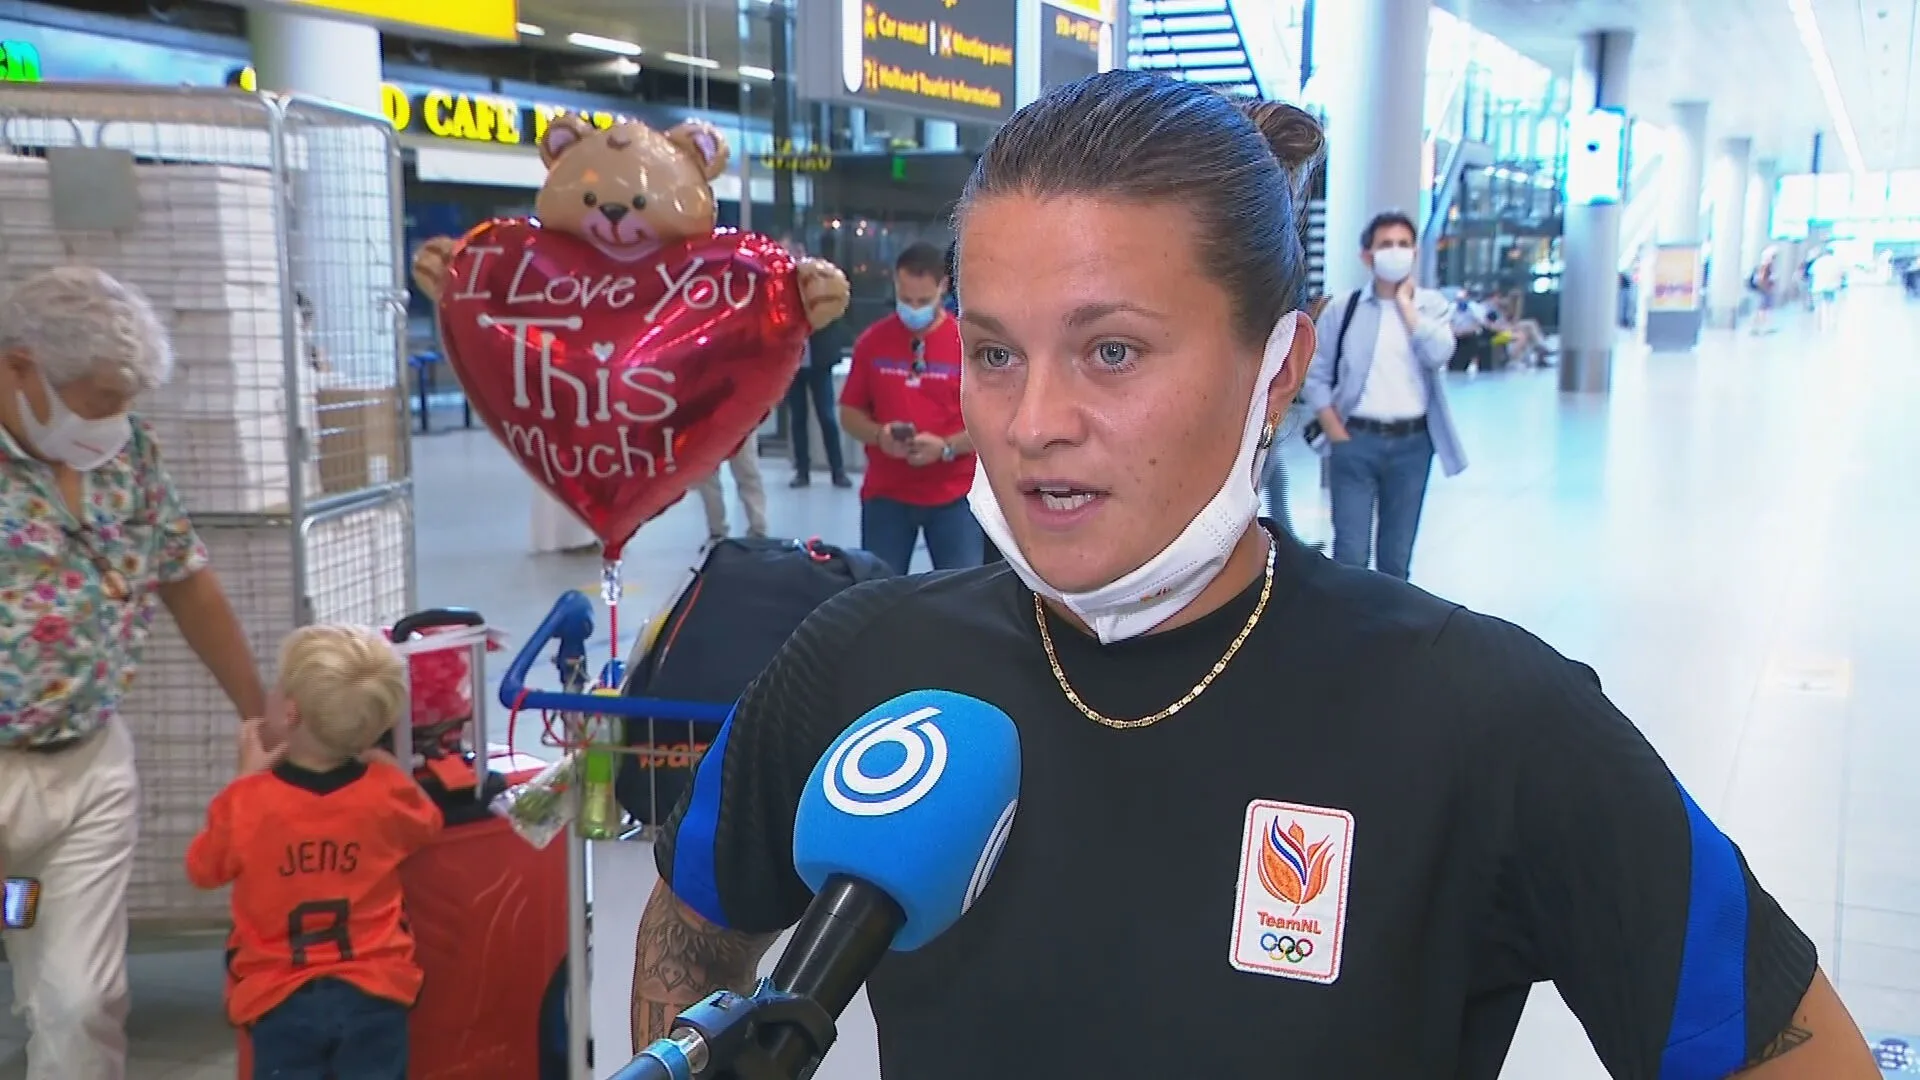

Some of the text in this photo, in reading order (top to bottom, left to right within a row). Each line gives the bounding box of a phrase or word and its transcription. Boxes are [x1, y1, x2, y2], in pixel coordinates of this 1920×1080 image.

[879, 12, 897, 38] Car
[424, 89, 521, 144] CAFE
[454, 246, 504, 300] I
[507, 250, 636, 308] Love
[477, 313, 678, 427] This
[1257, 911, 1322, 935] TeamNL
